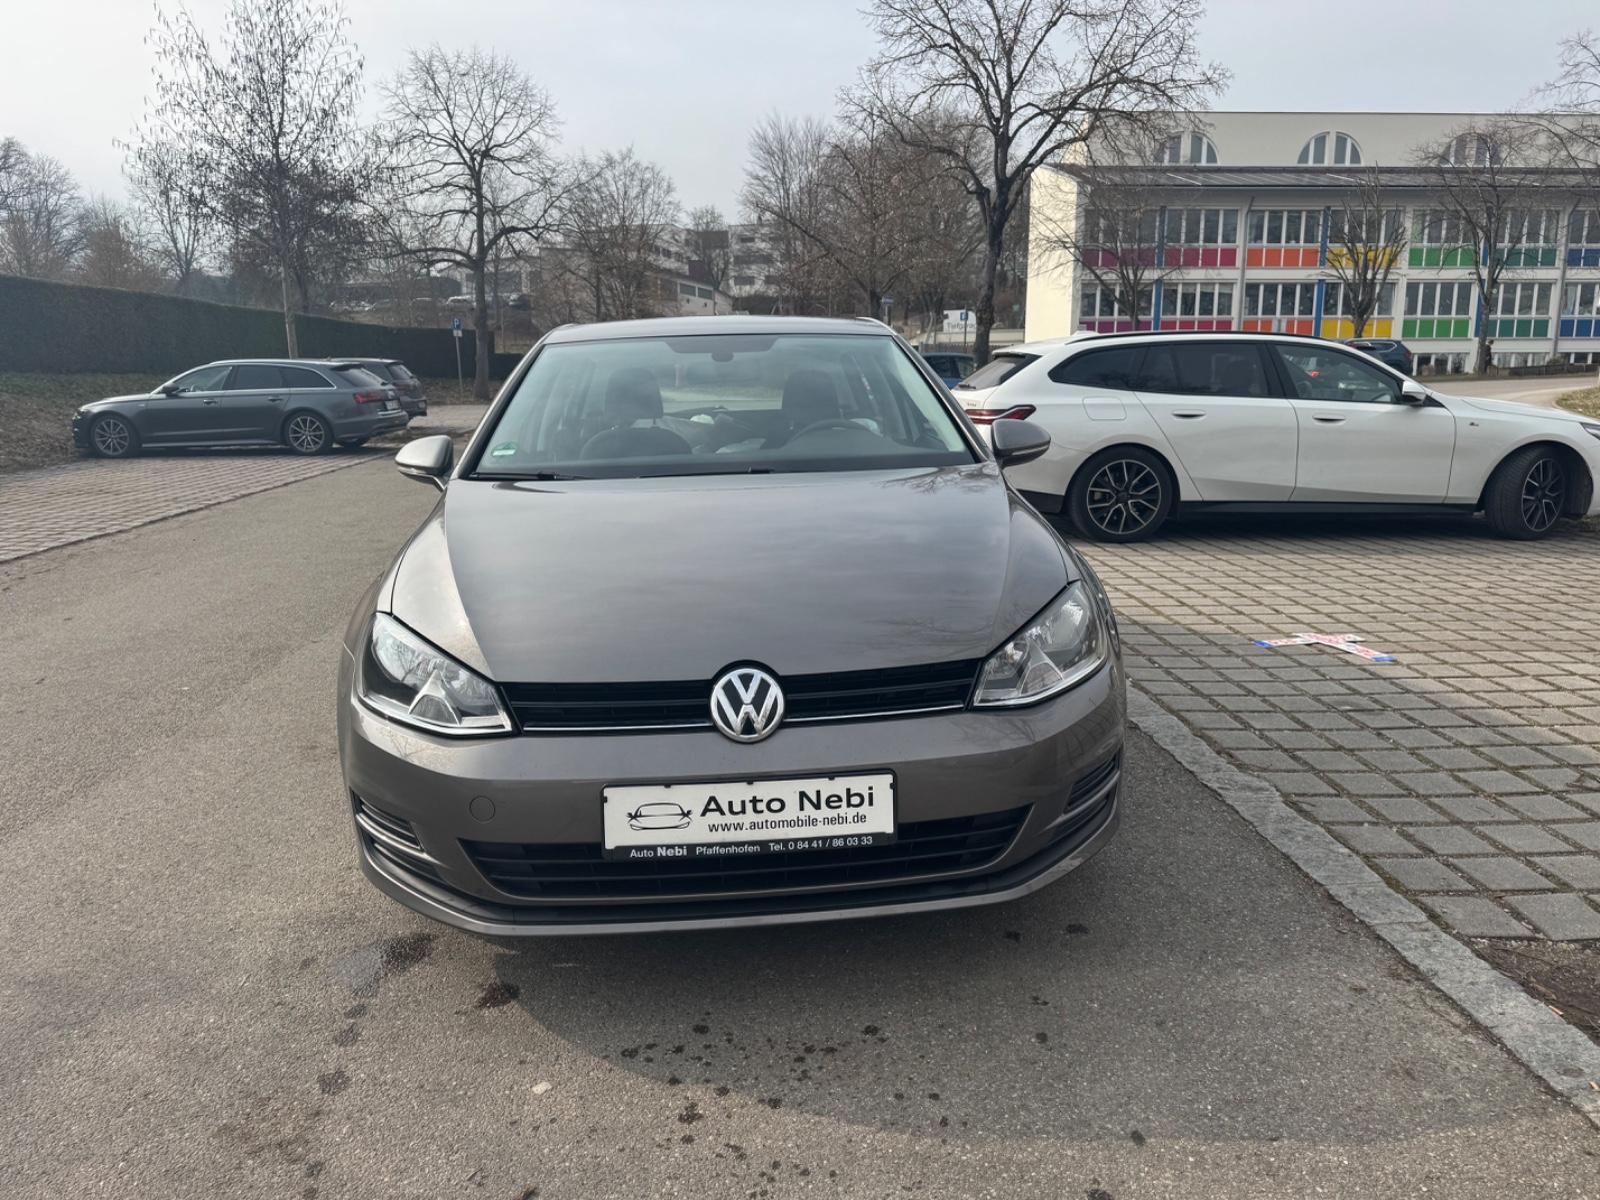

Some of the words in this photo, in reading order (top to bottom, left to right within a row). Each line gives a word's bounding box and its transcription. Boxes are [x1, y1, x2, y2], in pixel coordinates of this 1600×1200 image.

[700, 795, 786, 817] Auto
[798, 786, 875, 812] Nebi
[707, 811, 867, 833] www.automobile-nebi.de
[630, 848, 654, 858] Auto
[657, 845, 687, 857] Nebi
[696, 843, 761, 855] Pfaffenhofen
[768, 842, 786, 852] Tel.
[788, 841, 795, 850] 0
[797, 840, 809, 849] 84
[811, 839, 823, 848] 41
